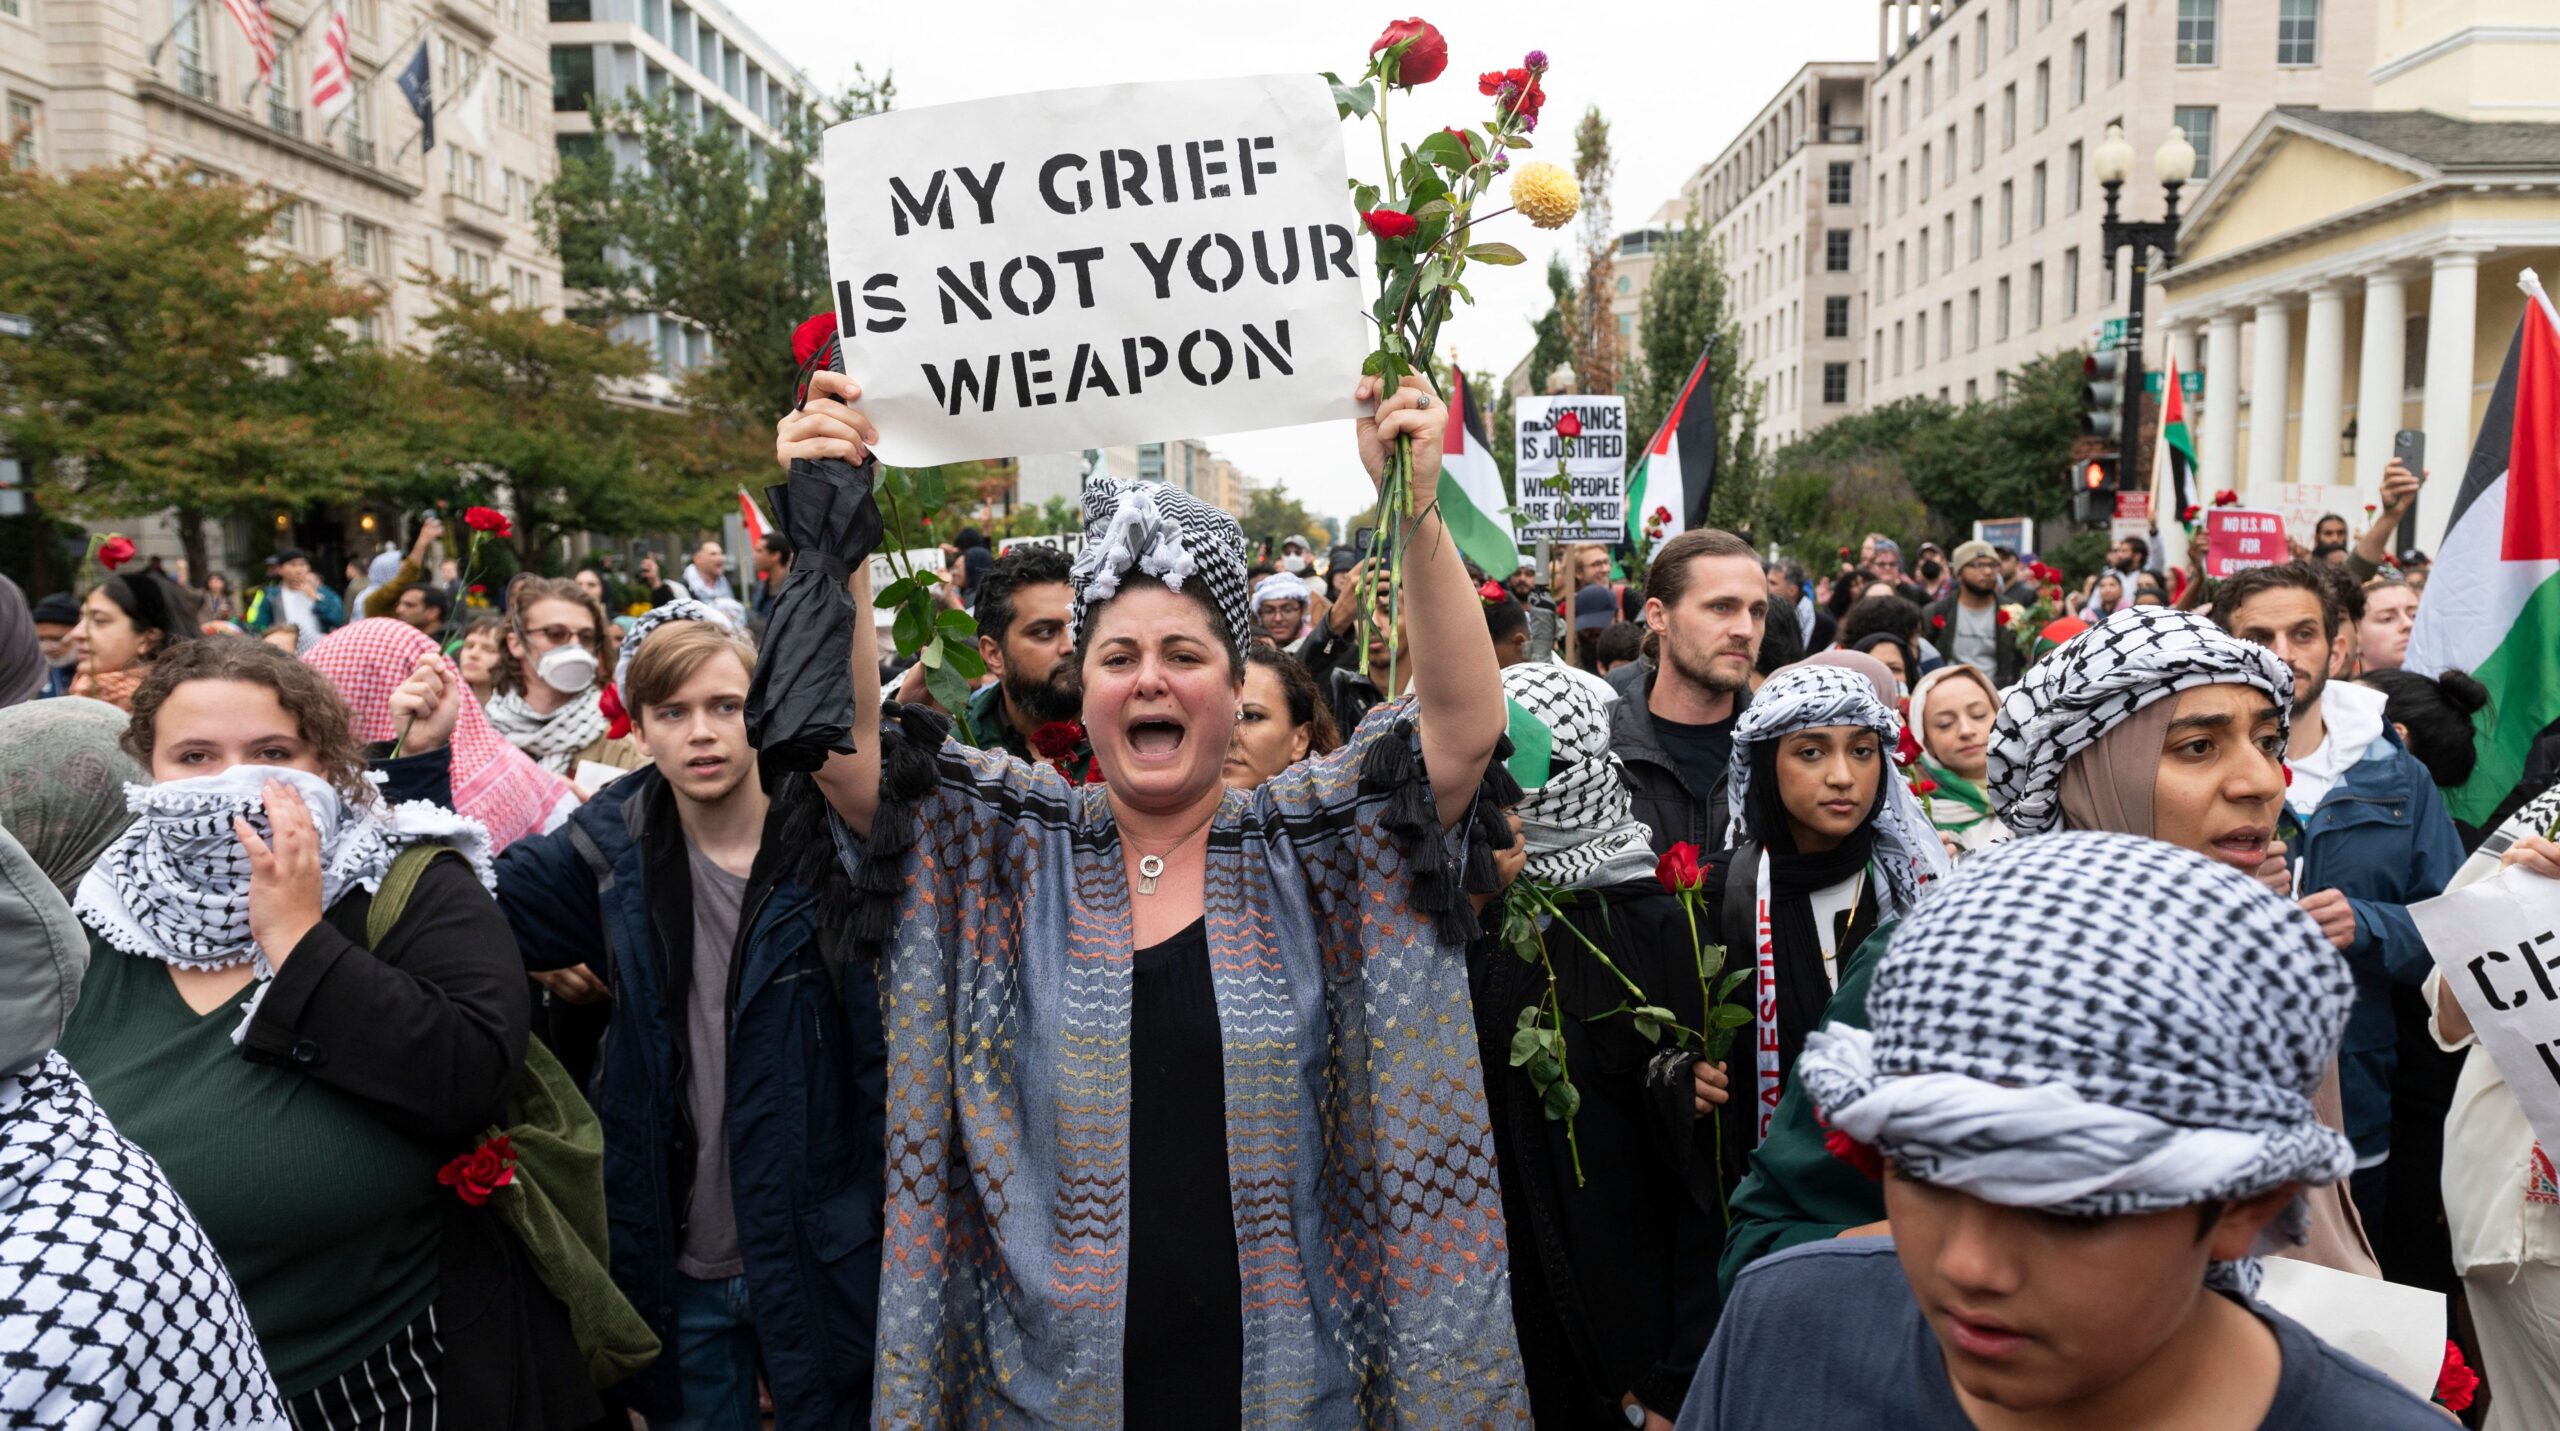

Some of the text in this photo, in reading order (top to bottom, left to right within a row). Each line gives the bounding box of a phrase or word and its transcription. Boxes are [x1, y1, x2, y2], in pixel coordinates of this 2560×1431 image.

[889, 136, 1278, 237] MY GRIEF
[837, 223, 1359, 339] IS NOT YOUR
[921, 319, 1294, 416] WEAPON
[1523, 434, 1622, 460] IS JUSTIFIED
[1571, 477, 1620, 497] PEOPLE
[2222, 516, 2239, 533] NO
[2261, 518, 2277, 533] AID
[2239, 537, 2261, 554] FOR
